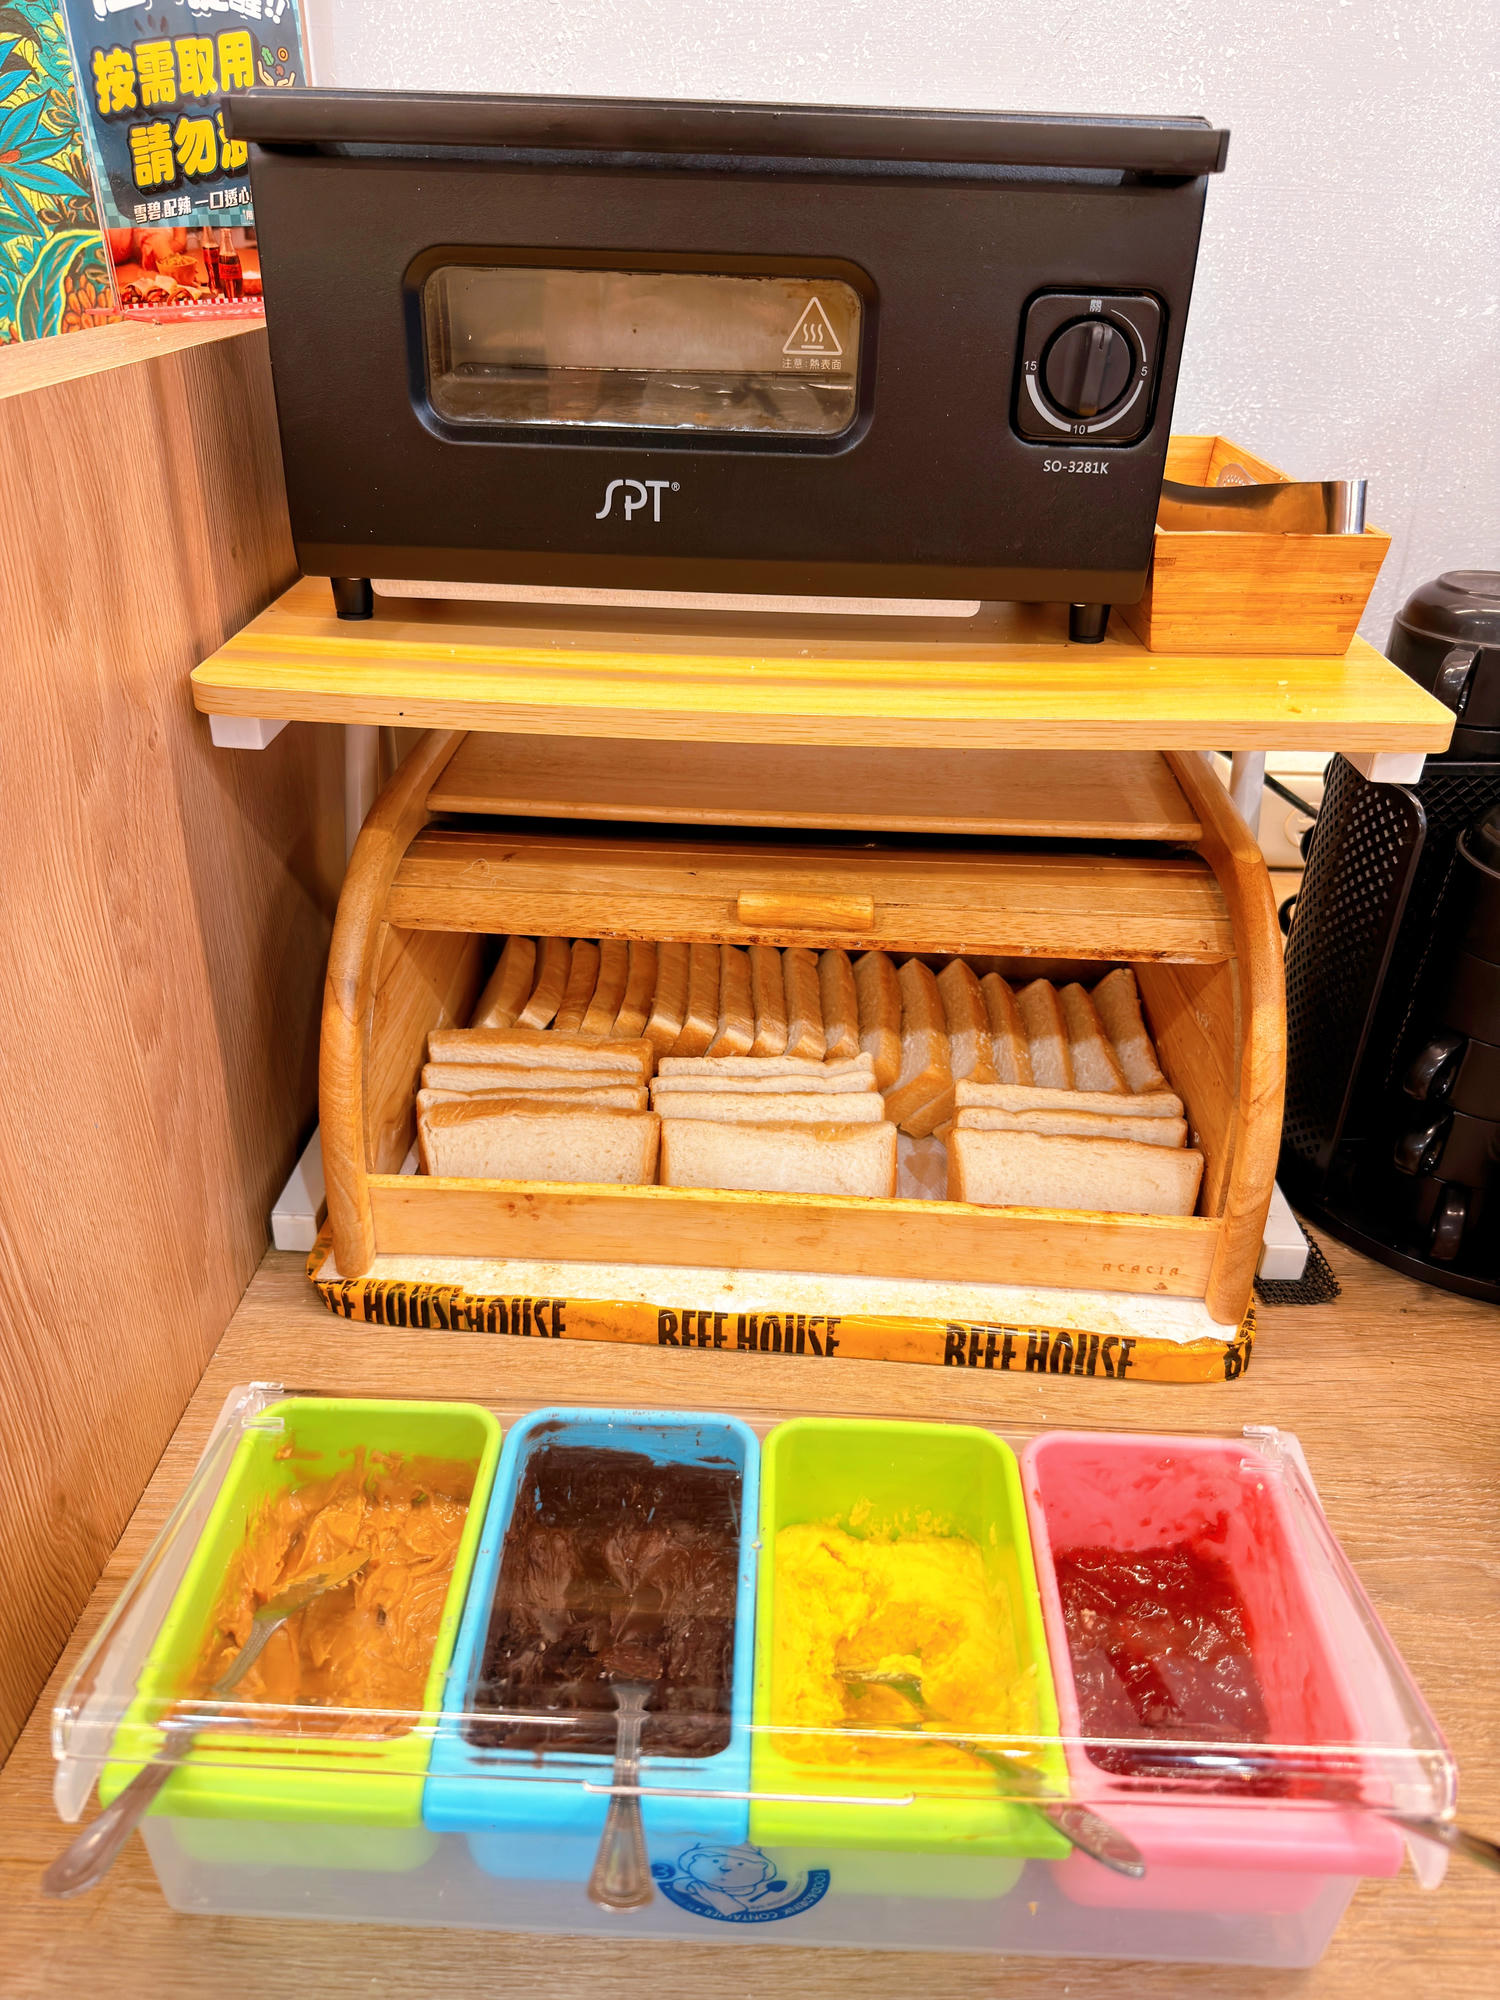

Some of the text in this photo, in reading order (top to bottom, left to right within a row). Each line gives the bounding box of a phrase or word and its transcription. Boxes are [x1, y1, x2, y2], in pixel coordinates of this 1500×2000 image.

[92, 31, 255, 115] 按需取用
[194, 186, 253, 211] 一口透心
[1024, 361, 1037, 372] 15
[1140, 366, 1148, 377] 5
[1072, 424, 1086, 435] 10
[1043, 459, 1110, 475] SO-3281K
[1101, 1262, 1180, 1277] ACACIA
